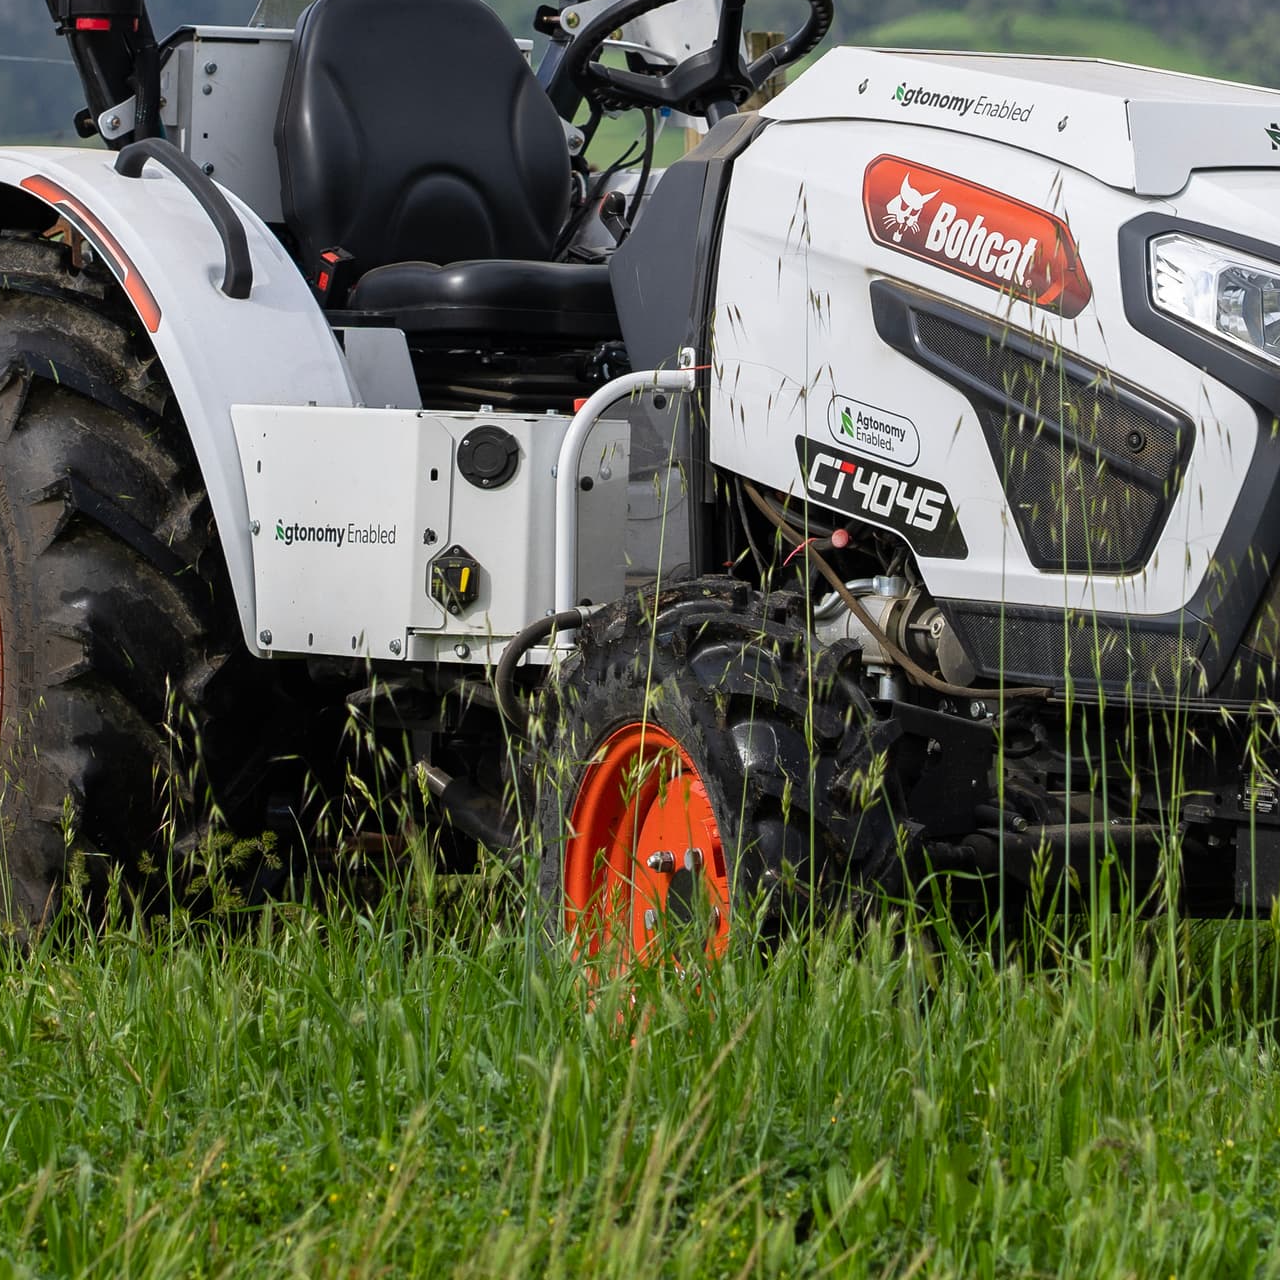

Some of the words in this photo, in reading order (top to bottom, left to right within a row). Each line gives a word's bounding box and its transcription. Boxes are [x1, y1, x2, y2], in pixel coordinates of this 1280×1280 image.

[891, 82, 975, 116] Agtonomy
[973, 96, 1034, 122] Enabled
[925, 201, 1038, 286] Bobcat
[856, 411, 906, 442] Agtonomy
[856, 426, 892, 450] Enabled
[808, 452, 947, 531] CT4045
[275, 519, 345, 548] Agtonomy
[347, 523, 397, 544] Enabled
